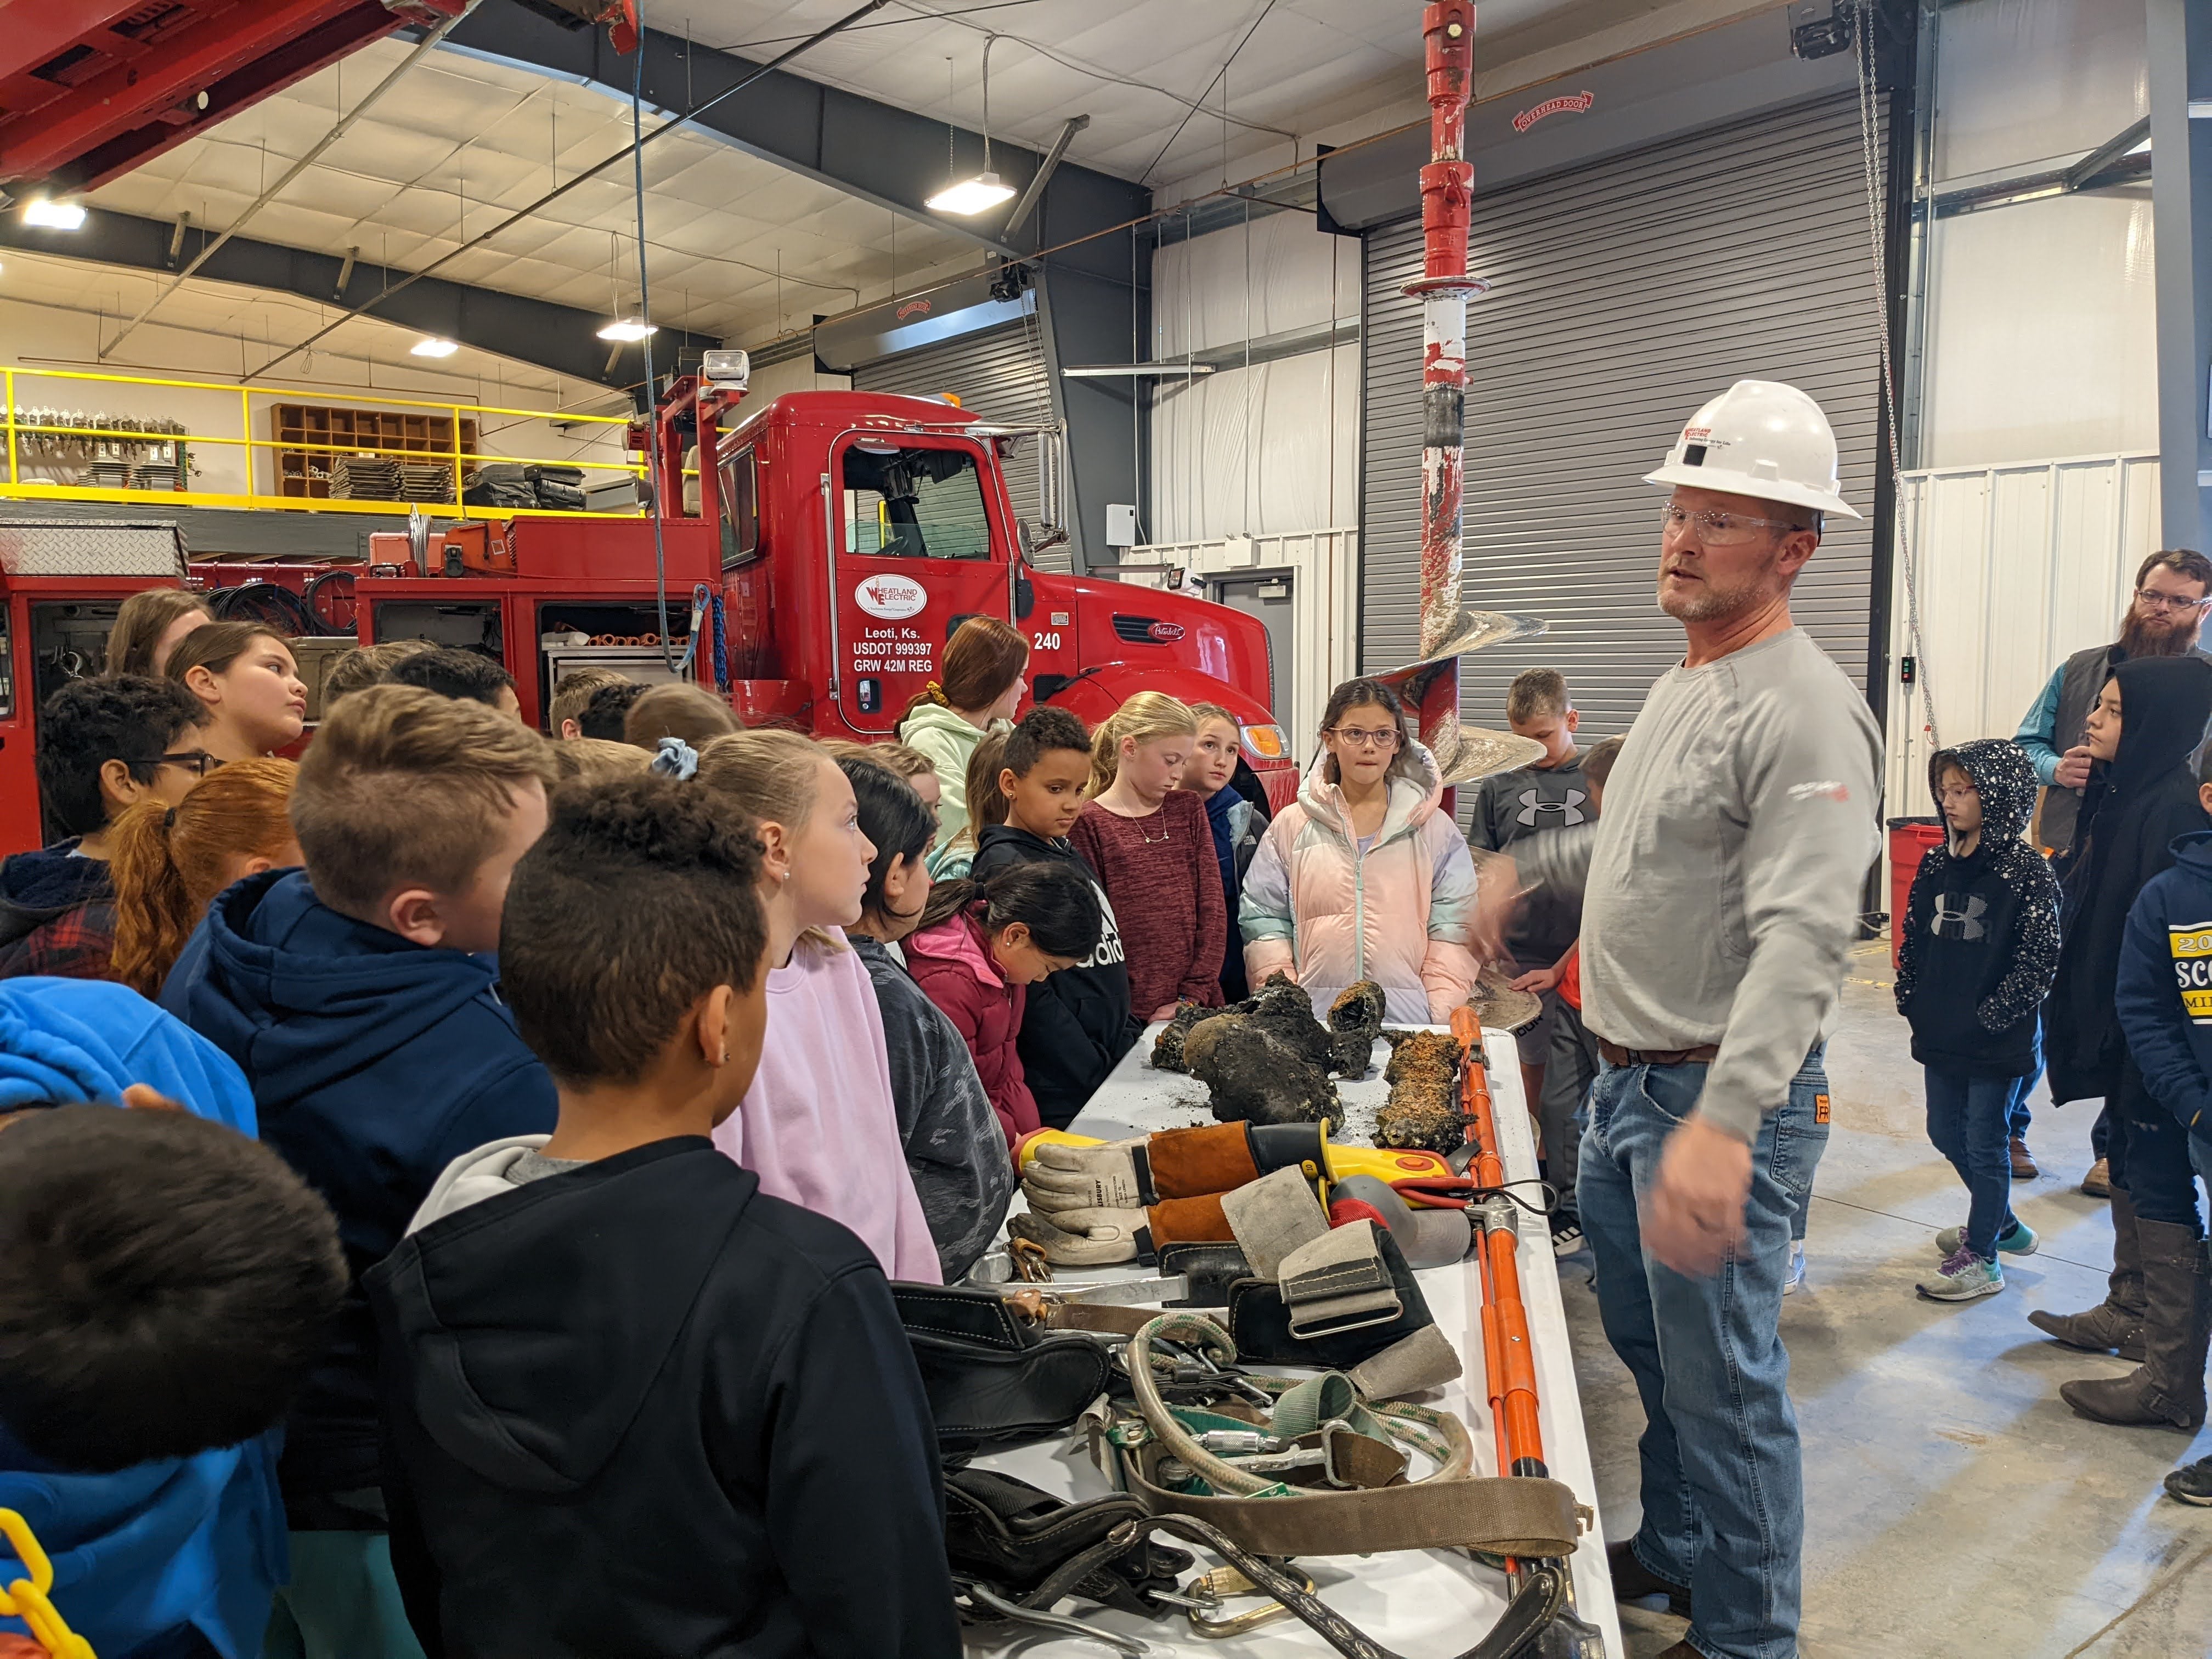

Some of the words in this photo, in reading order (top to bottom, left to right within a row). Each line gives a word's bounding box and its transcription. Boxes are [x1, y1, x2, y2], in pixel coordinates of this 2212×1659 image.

[1522, 101, 1561, 127] OVERHEAD
[1563, 100, 1583, 109] DOOR
[866, 586, 917, 603] WHEATLAND
[878, 594, 916, 605] ELECTRIC
[865, 627, 898, 640] Leoti,
[901, 628, 920, 639] Ks.
[1155, 627, 1182, 636] Peterbilt
[1034, 633, 1060, 650] 240
[853, 642, 893, 655] USDOT
[895, 643, 932, 655] 999397
[854, 659, 881, 672] GRW
[884, 659, 906, 672] 42M
[909, 659, 932, 672] REG
[2185, 996, 2212, 1008] MI
[1095, 1179, 1104, 1207] LISBURY
